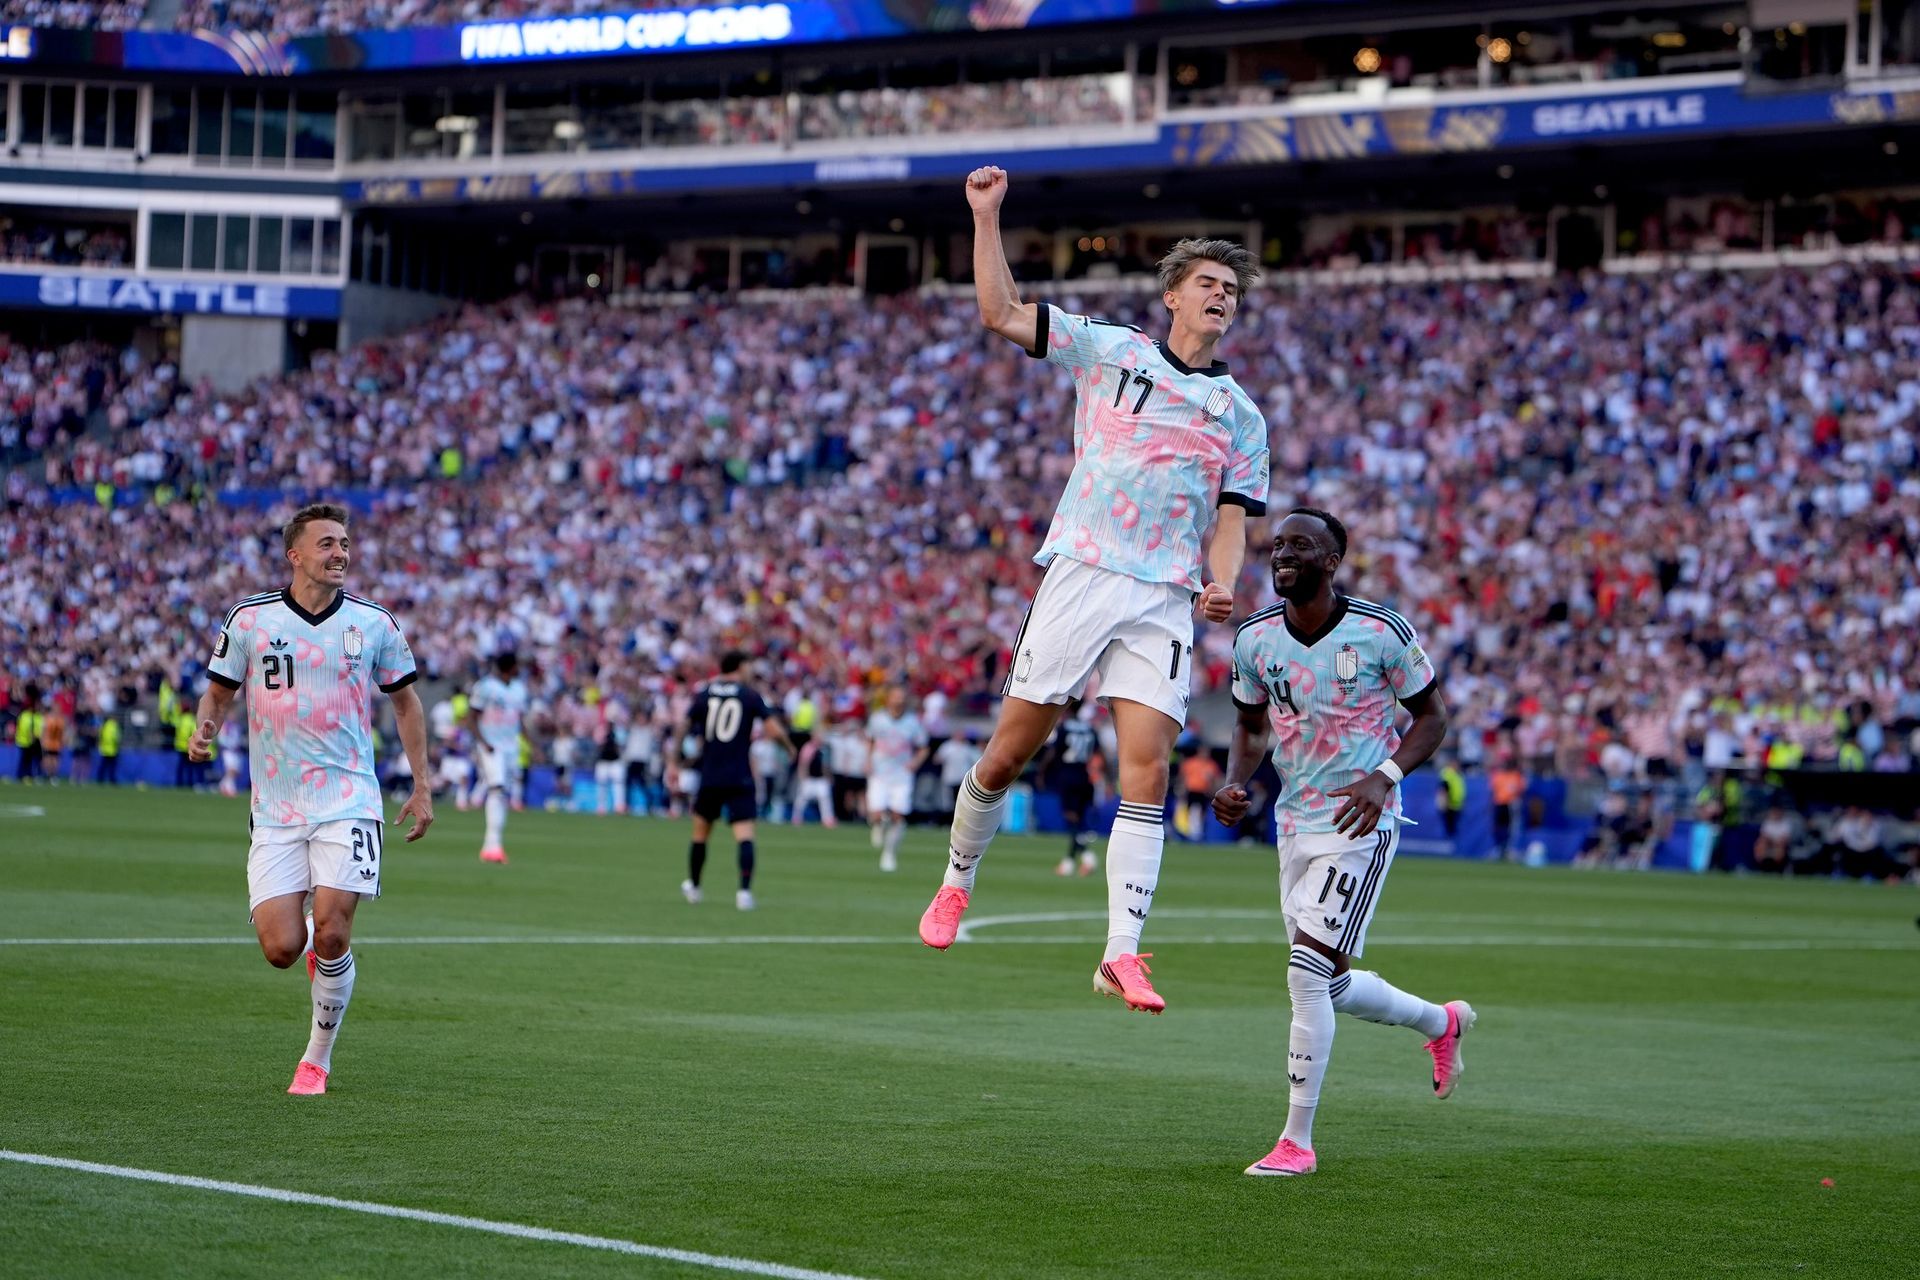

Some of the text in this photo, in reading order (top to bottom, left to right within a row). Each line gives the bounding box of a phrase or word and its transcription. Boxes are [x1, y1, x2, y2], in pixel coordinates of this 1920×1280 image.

[461, 23, 522, 59] FIFA
[521, 16, 625, 55] WORLD
[626, 11, 686, 48] CUP
[1534, 95, 1704, 134] SEATTLE
[38, 274, 288, 314] SEATTLE
[1113, 369, 1154, 414] 17
[263, 655, 293, 690] 21
[1170, 639, 1192, 680] 1
[705, 697, 742, 742] 10
[351, 827, 376, 862] 21
[1318, 866, 1357, 912] 14
